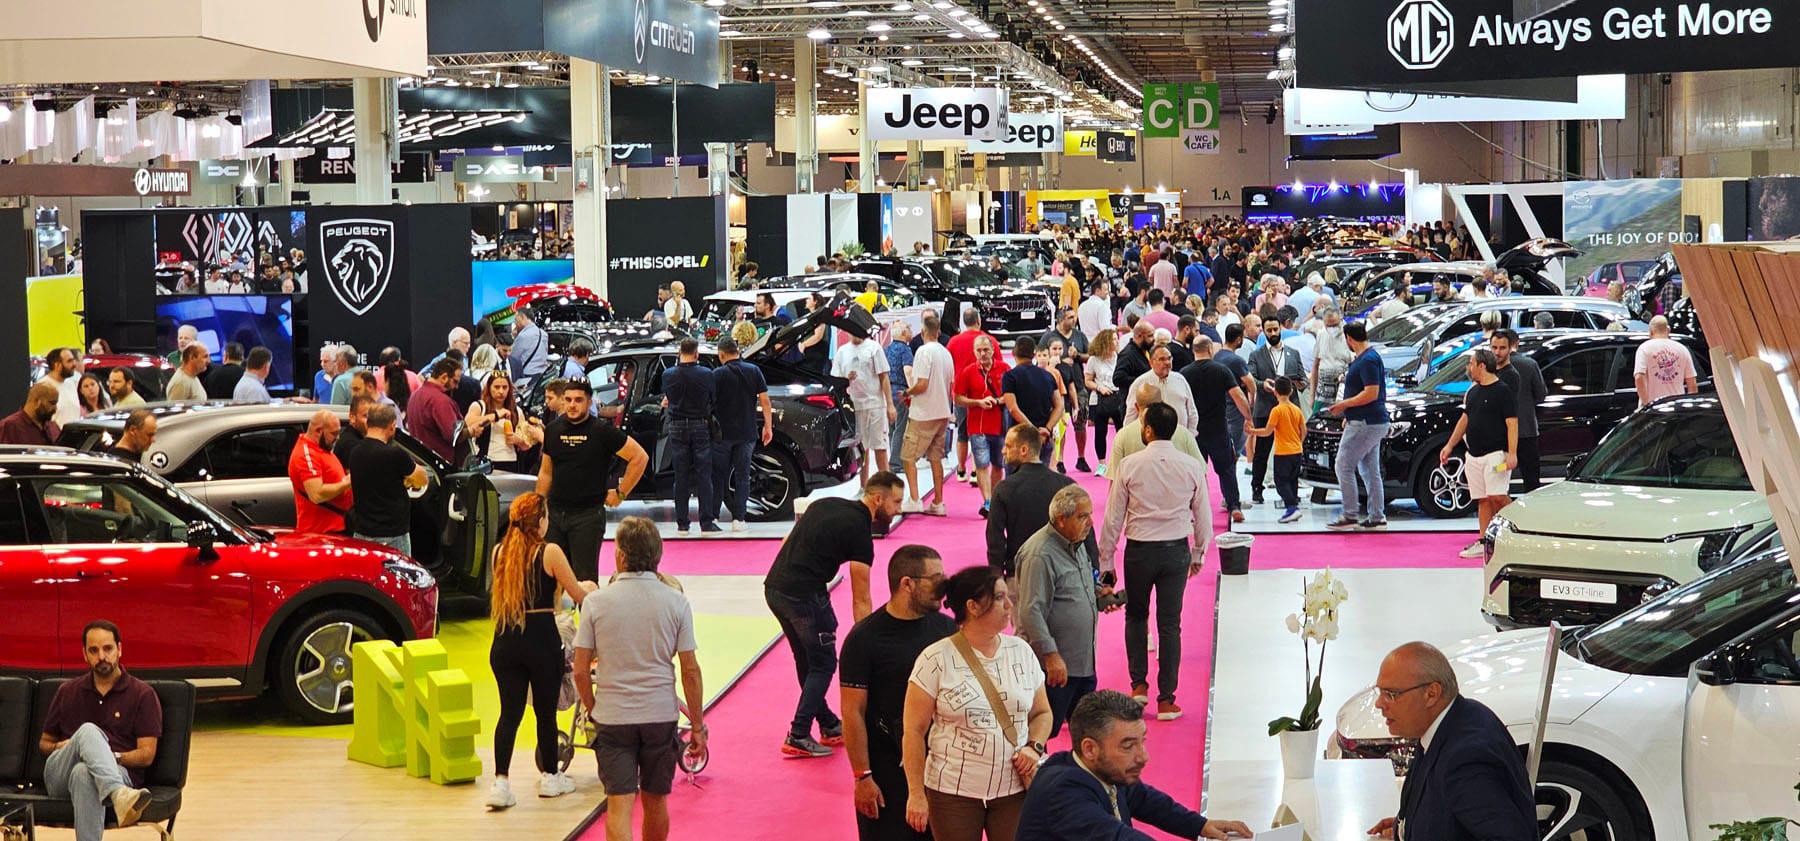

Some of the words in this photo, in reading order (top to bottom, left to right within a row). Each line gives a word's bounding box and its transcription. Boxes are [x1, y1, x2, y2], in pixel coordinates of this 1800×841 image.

[1393, 3, 1448, 62] MG
[1469, 14, 1593, 51] Always
[1602, 7, 1667, 41] Get
[1677, 3, 1772, 37] More
[884, 94, 990, 136] Jeep
[1149, 99, 1174, 129] C
[1187, 98, 1213, 129] D
[979, 123, 1055, 148] eep
[320, 160, 405, 175] RENT
[151, 171, 189, 193] HYUNDAI
[326, 226, 388, 238] PEUGEOT
[1587, 234, 1613, 246] THE
[1616, 233, 1641, 246] JOY
[1645, 232, 1664, 244] OF
[1552, 584, 1571, 595] EV3
[1572, 586, 1605, 598] GT-line
